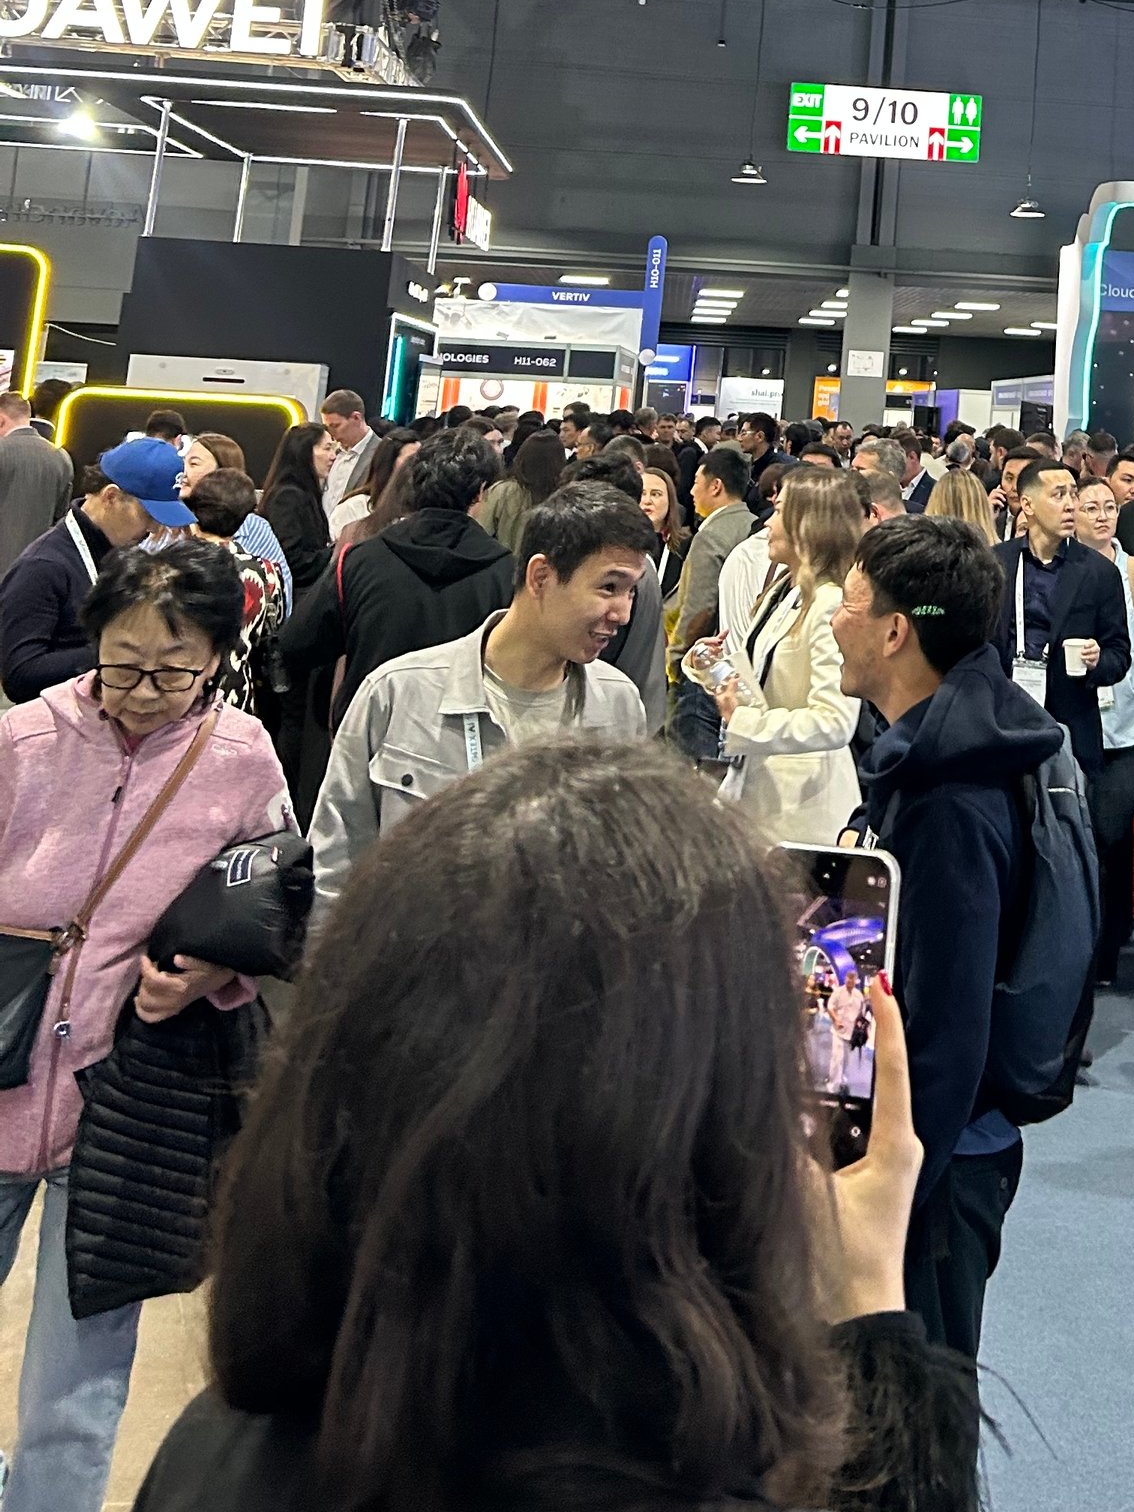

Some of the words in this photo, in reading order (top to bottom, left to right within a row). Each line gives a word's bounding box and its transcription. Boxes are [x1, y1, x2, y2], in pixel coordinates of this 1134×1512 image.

[793, 92, 822, 109] EXIT
[852, 97, 918, 125] 9/10
[850, 132, 919, 148] PAVILION
[650, 249, 661, 288] H10-011
[552, 291, 590, 302] VERTIV
[514, 356, 557, 368] H11-062
